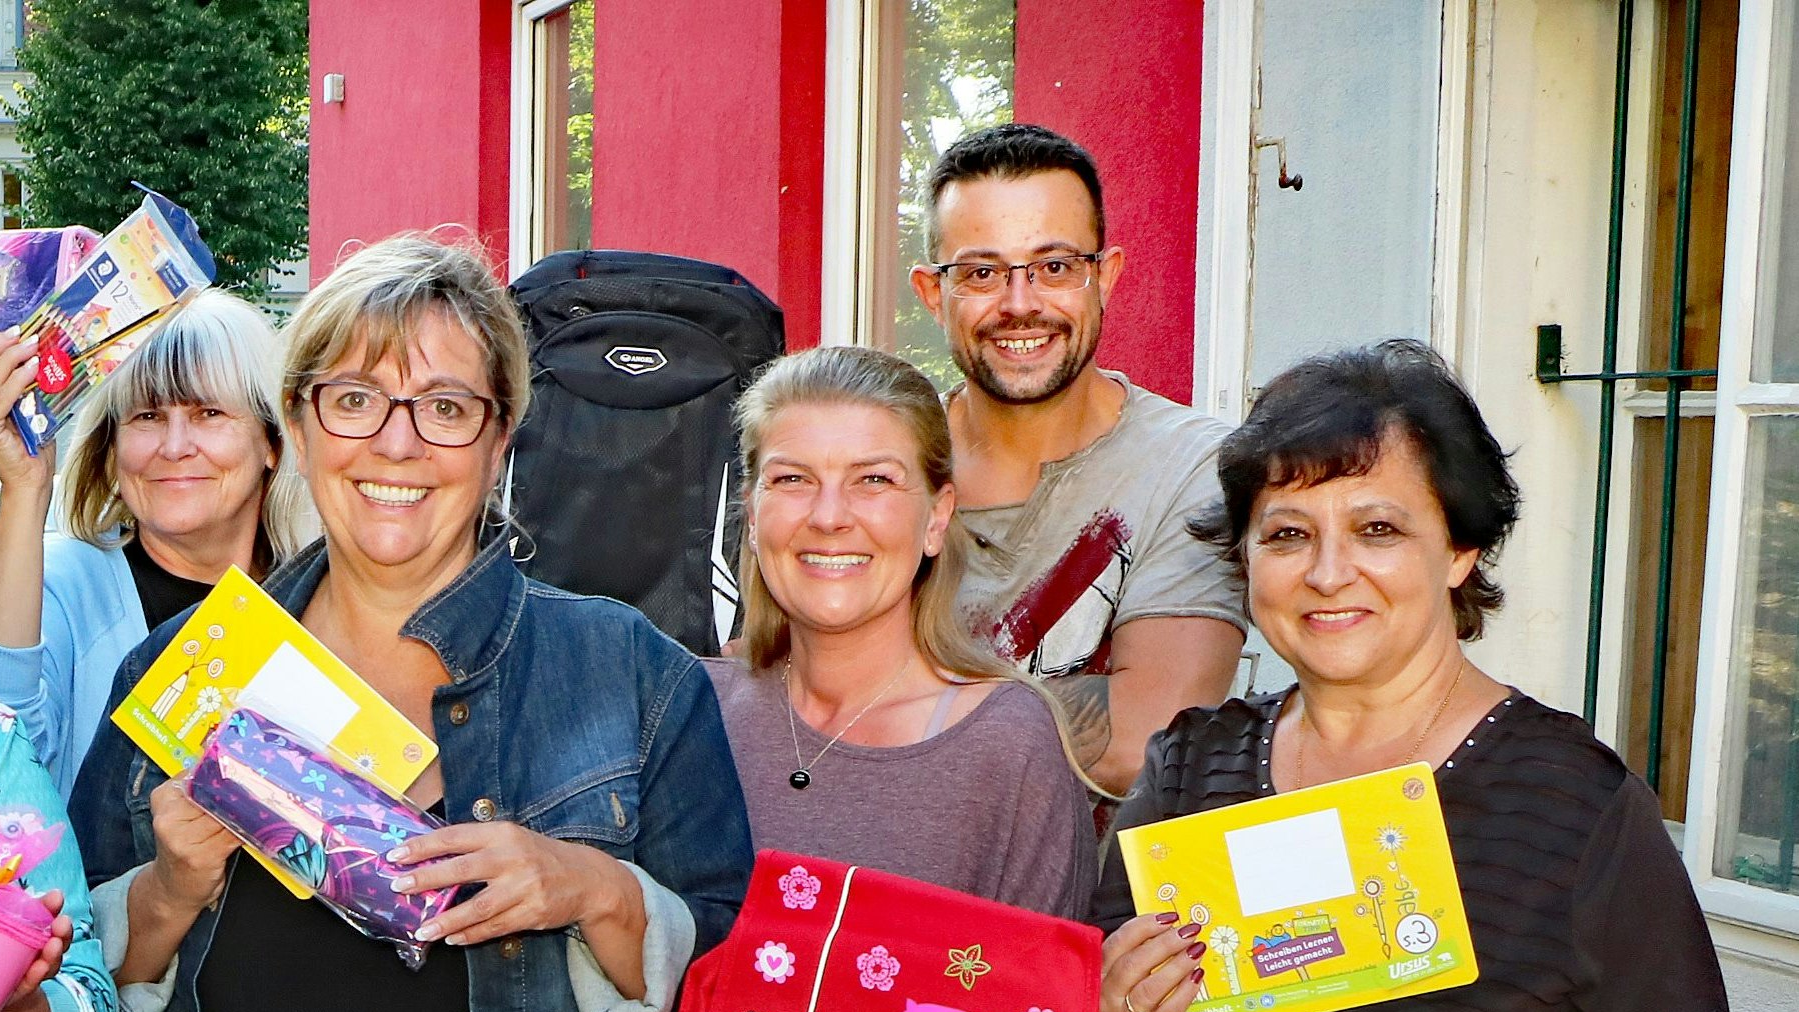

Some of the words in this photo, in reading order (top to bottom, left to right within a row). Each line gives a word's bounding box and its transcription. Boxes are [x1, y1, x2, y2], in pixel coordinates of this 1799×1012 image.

[110, 280, 129, 303] 12
[43, 365, 57, 385] PACK
[48, 355, 67, 381] BONUS
[1257, 944, 1303, 963] Schreiben
[1302, 935, 1334, 948] Lernen
[1264, 958, 1293, 972] Leicht
[1293, 947, 1333, 965] gemacht
[1388, 954, 1431, 979] Ursus
